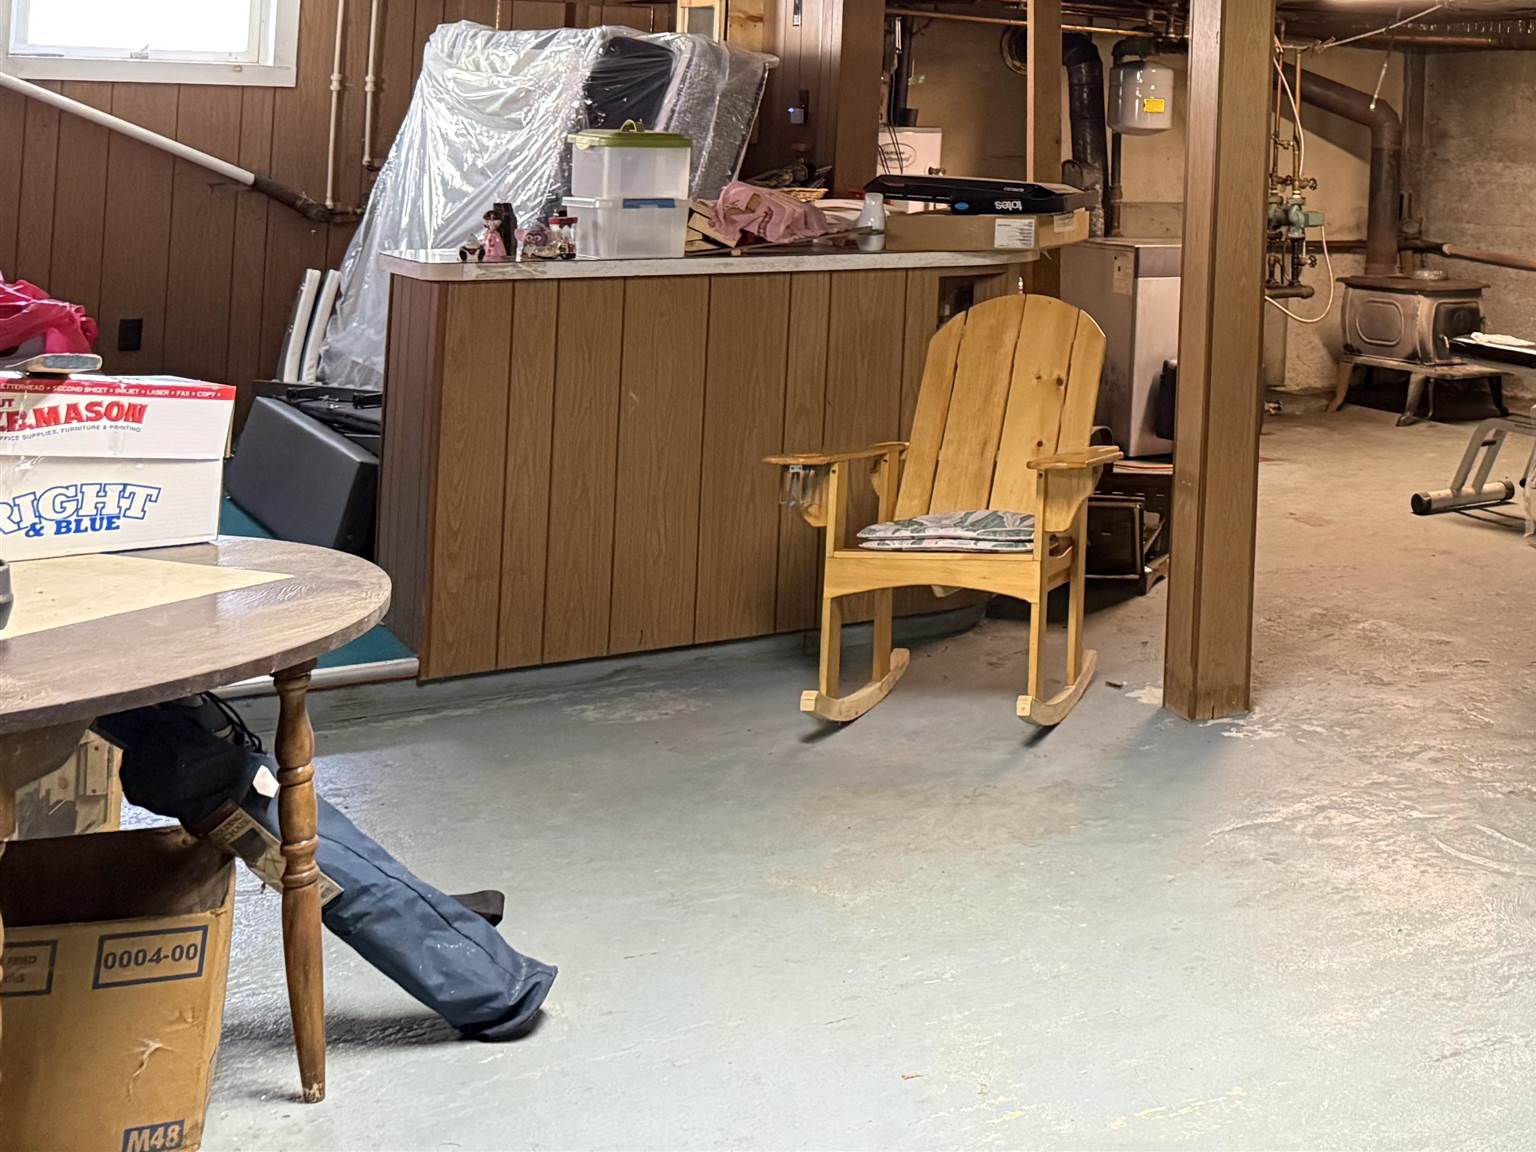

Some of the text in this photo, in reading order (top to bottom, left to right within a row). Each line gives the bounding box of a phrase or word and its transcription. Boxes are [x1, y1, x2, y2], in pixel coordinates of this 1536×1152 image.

[995, 200, 1023, 211] totes
[61, 425, 100, 433] FURNITURE
[109, 425, 142, 433] PRINTING
[25, 515, 121, 538] & BLUE
[104, 943, 198, 969] 0004-00
[127, 1124, 182, 1152] M48
